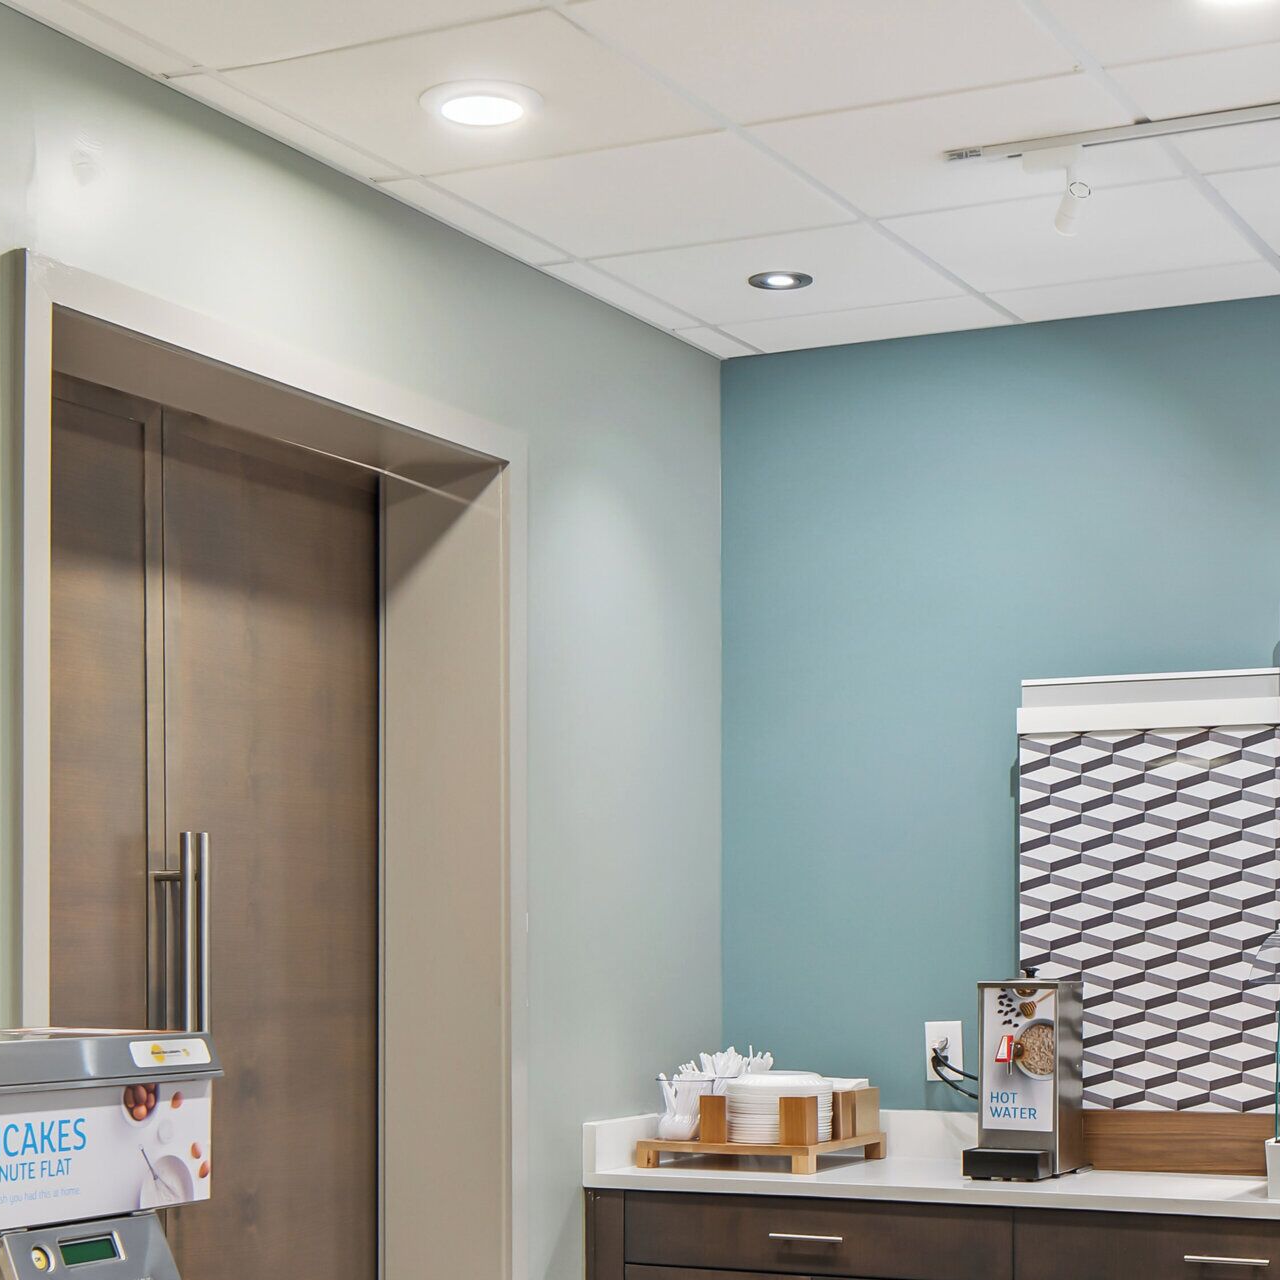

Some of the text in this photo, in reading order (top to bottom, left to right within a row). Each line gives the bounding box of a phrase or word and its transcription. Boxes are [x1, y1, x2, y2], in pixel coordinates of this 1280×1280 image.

[990, 1091, 1018, 1105] HOT
[989, 1106, 1038, 1120] WATER
[40, 1157, 72, 1178] FLAT
